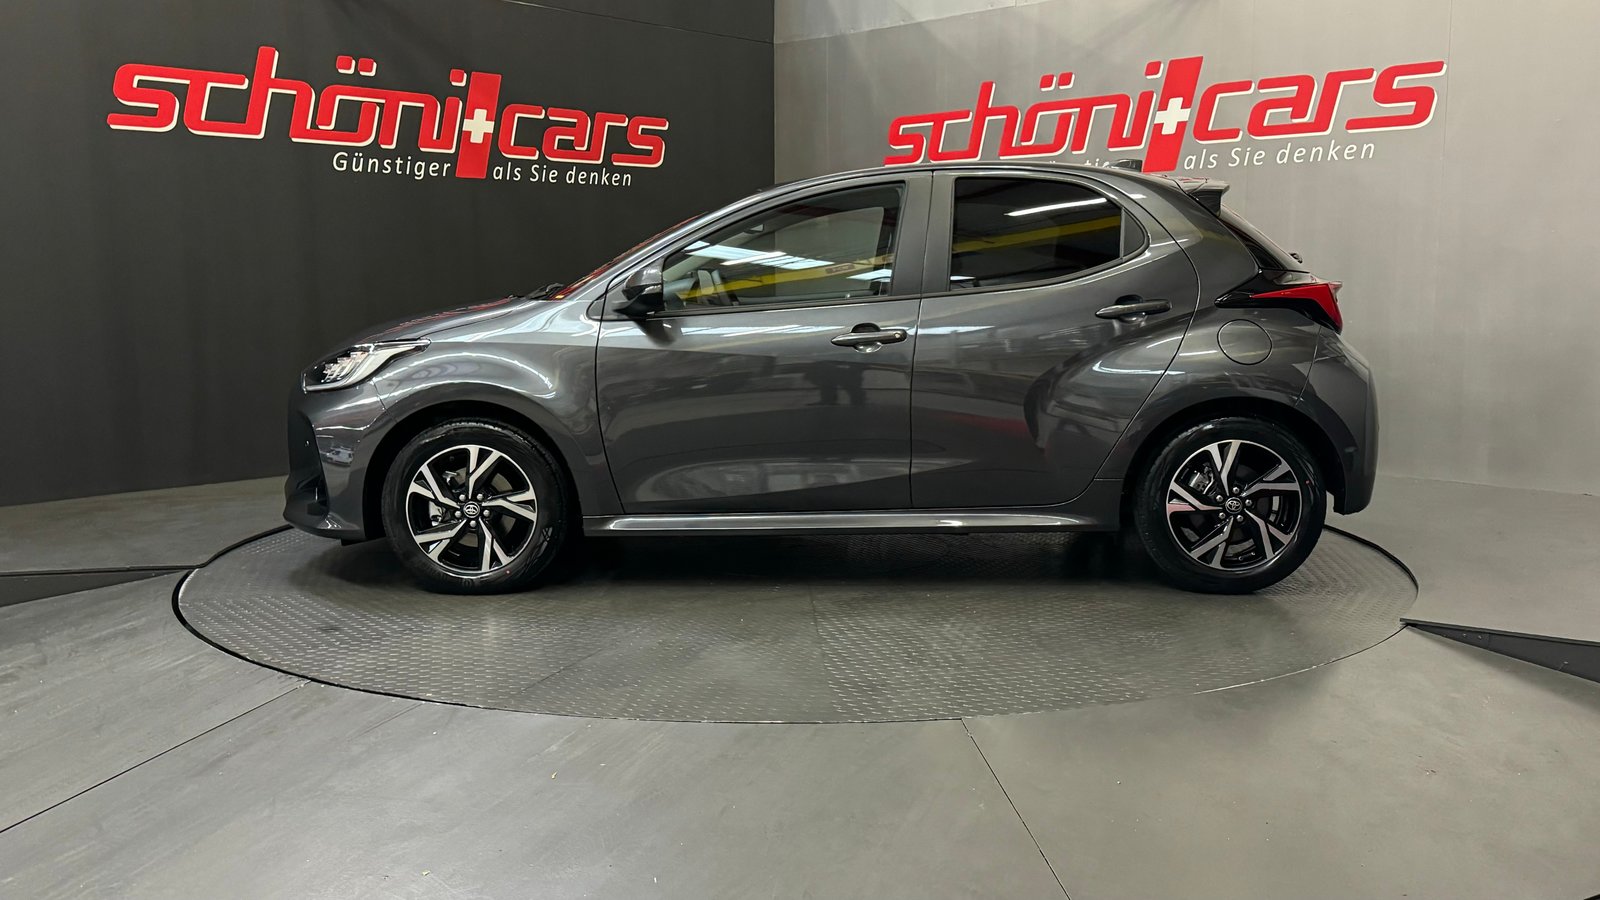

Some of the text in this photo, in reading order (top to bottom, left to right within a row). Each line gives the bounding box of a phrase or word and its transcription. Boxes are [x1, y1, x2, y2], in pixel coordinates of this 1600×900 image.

[332, 151, 632, 186] Günstiger als Sie denken
[1183, 139, 1376, 170] als Sie denken
